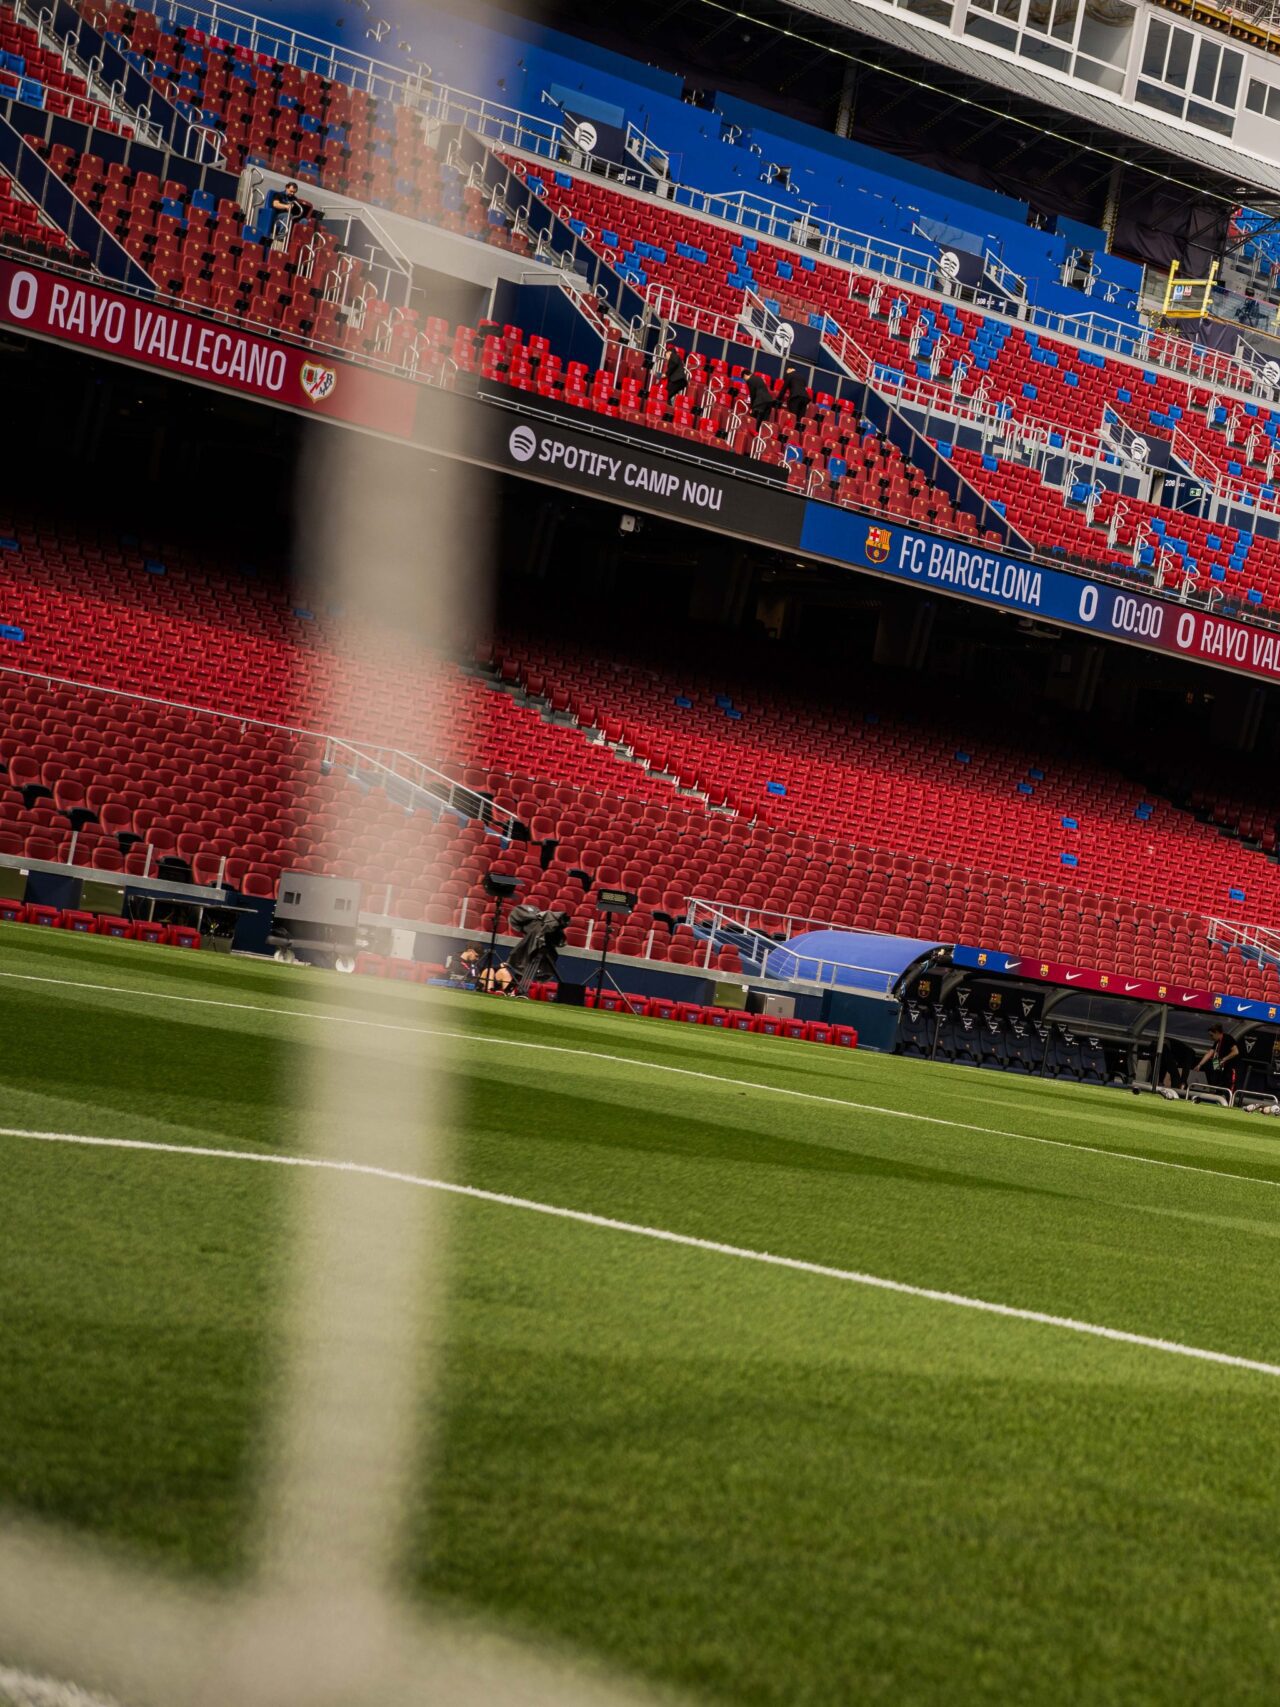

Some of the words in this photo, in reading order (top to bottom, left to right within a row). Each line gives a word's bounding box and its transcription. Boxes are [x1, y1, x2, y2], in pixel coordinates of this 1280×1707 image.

[48, 283, 127, 344] RAYO
[133, 307, 287, 391] VALLECANO
[538, 438, 622, 481] SPOTIFY
[623, 463, 680, 497] CAMP
[682, 479, 723, 510] NOU
[898, 535, 926, 573] FC
[927, 543, 1042, 606] BARCELONA
[1078, 585, 1099, 622] 0
[1111, 595, 1164, 638] 00:00
[1176, 612, 1196, 648] 0
[1200, 620, 1249, 661] RAYO
